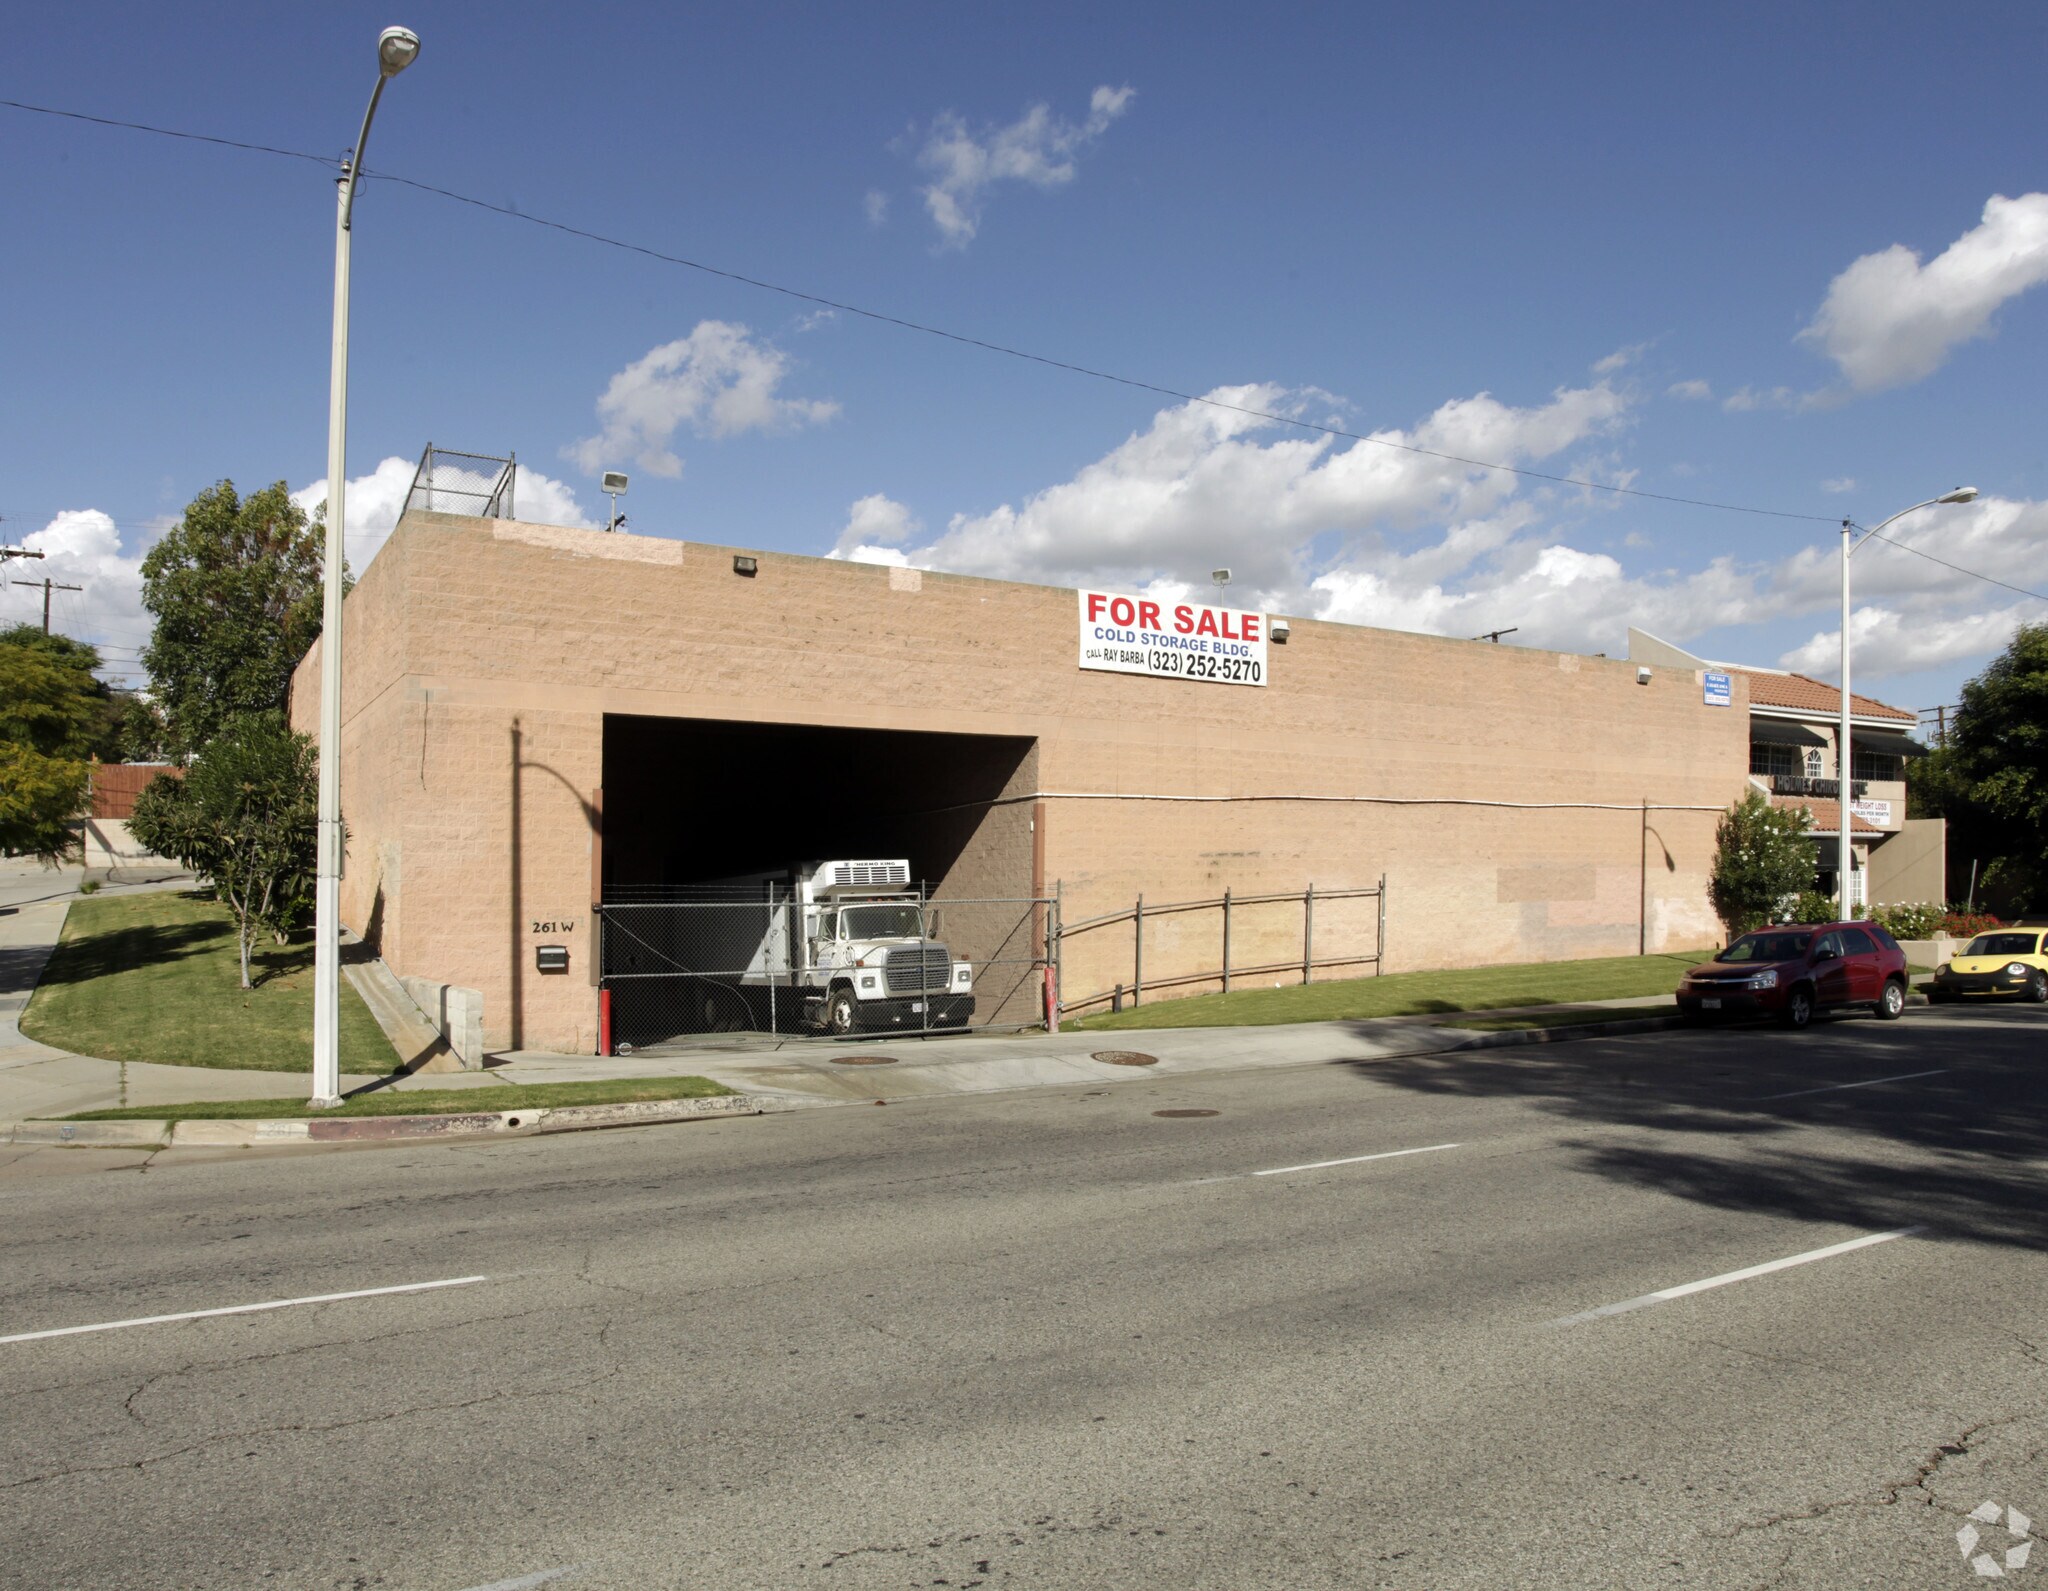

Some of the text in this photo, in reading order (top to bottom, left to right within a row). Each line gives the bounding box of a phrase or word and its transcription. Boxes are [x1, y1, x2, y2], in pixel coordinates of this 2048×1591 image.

[1087, 593, 1260, 642] FOR SALE
[1094, 626, 1253, 658] COLD STORAGE BLDG.
[1086, 648, 1261, 682] CALL RAY BARBA (323) 252-5270
[1777, 775, 1810, 792] HOLMES
[1875, 803, 1887, 811] LOSS
[532, 921, 574, 933] 261 W
